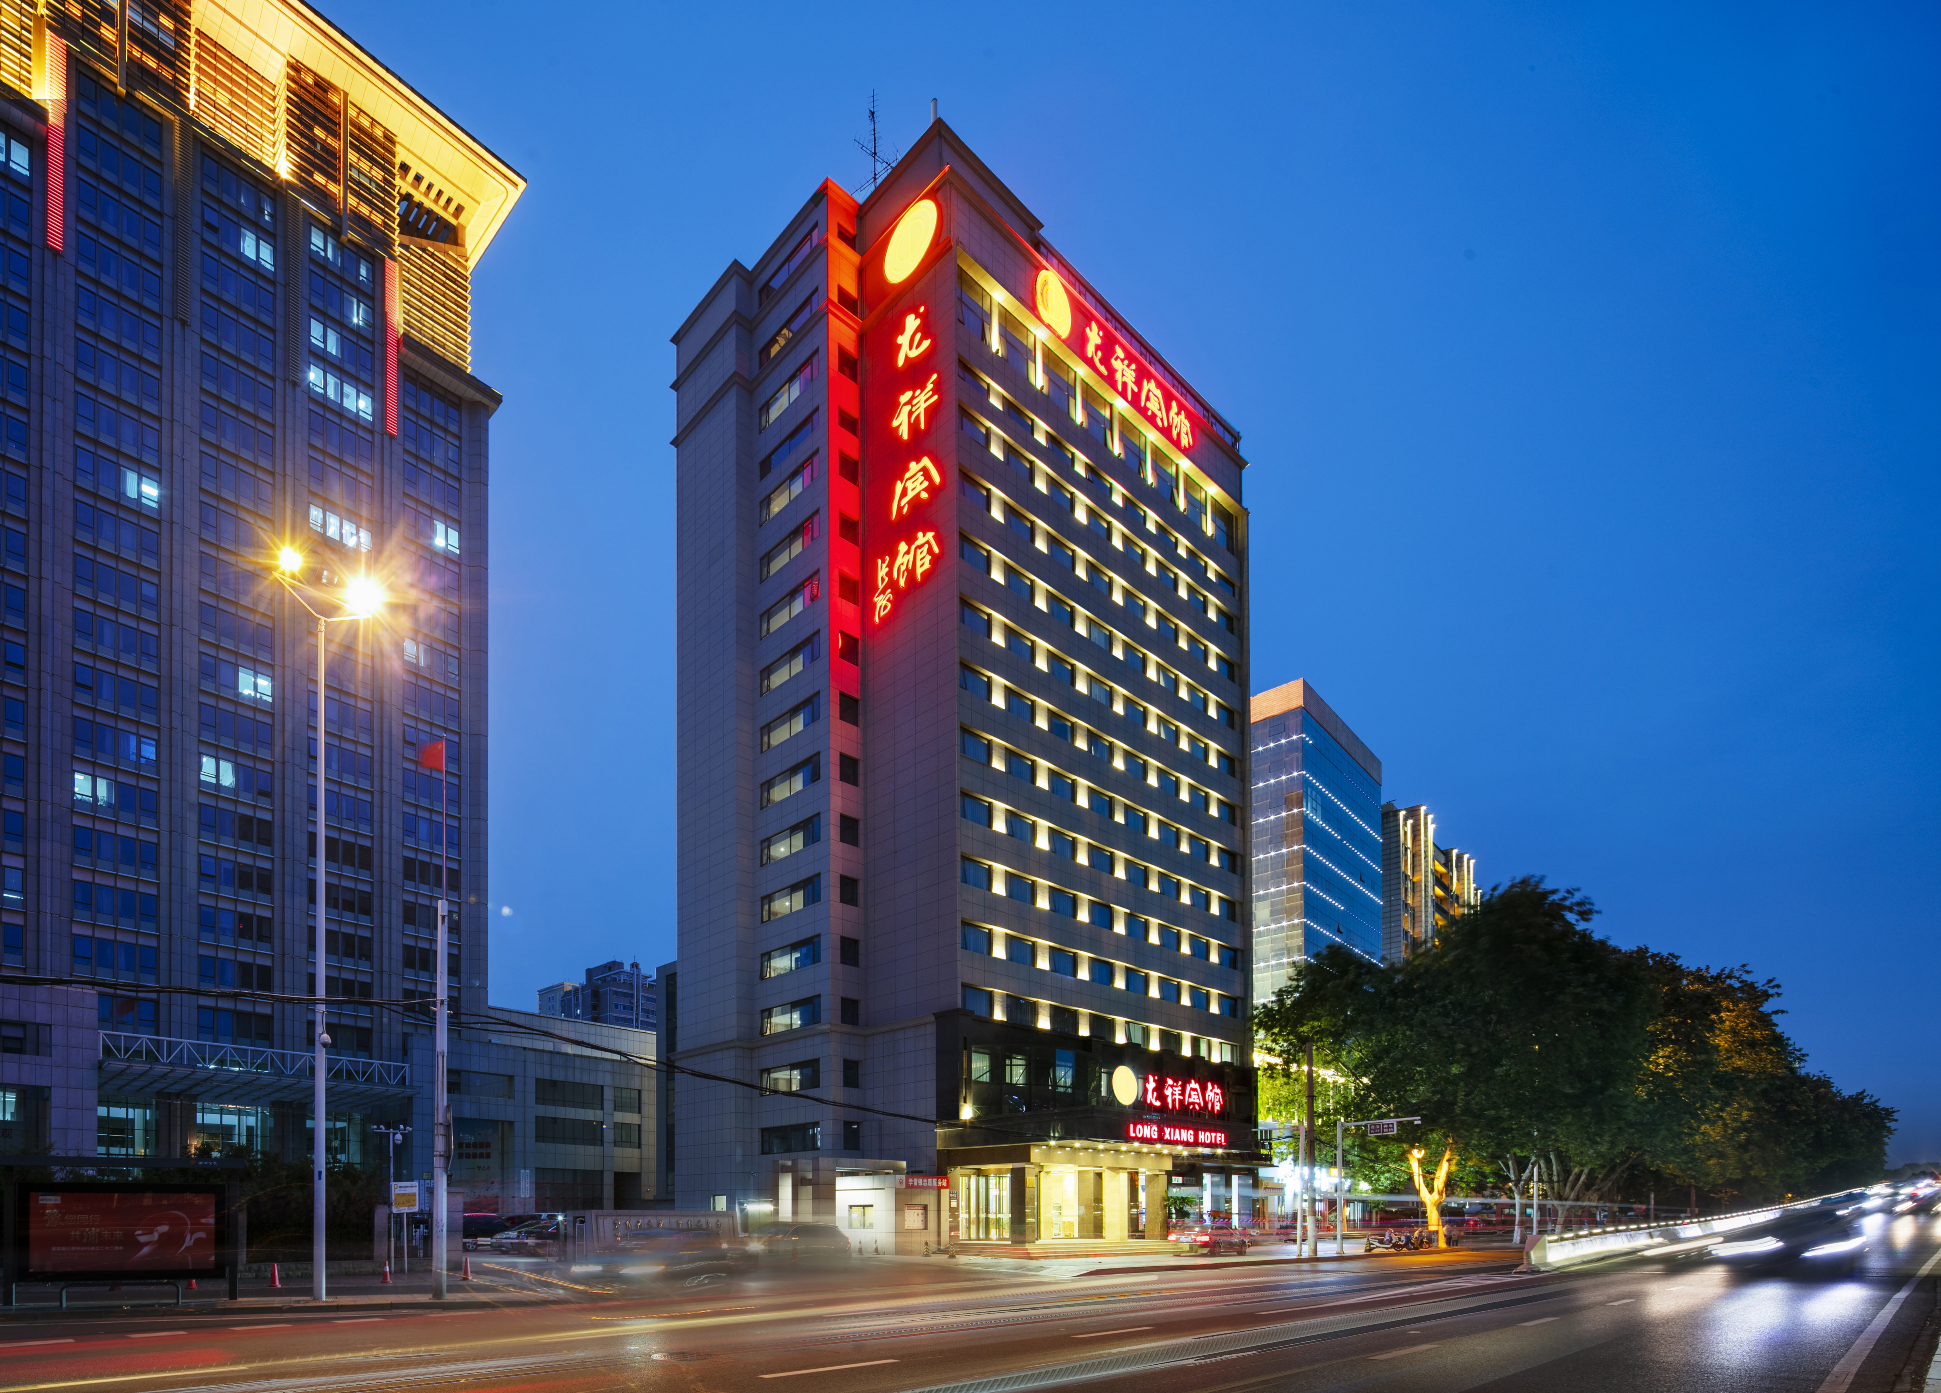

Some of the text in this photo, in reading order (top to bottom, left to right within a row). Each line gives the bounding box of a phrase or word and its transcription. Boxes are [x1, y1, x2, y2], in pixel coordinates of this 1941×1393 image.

[1085, 321, 1194, 449] 龙祥宾馆
[891, 305, 942, 589] 龙祥宾馆
[1129, 1123, 1227, 1146] LONG XIANG HOTEL
[1146, 1074, 1223, 1114] 龙祥宾馆
